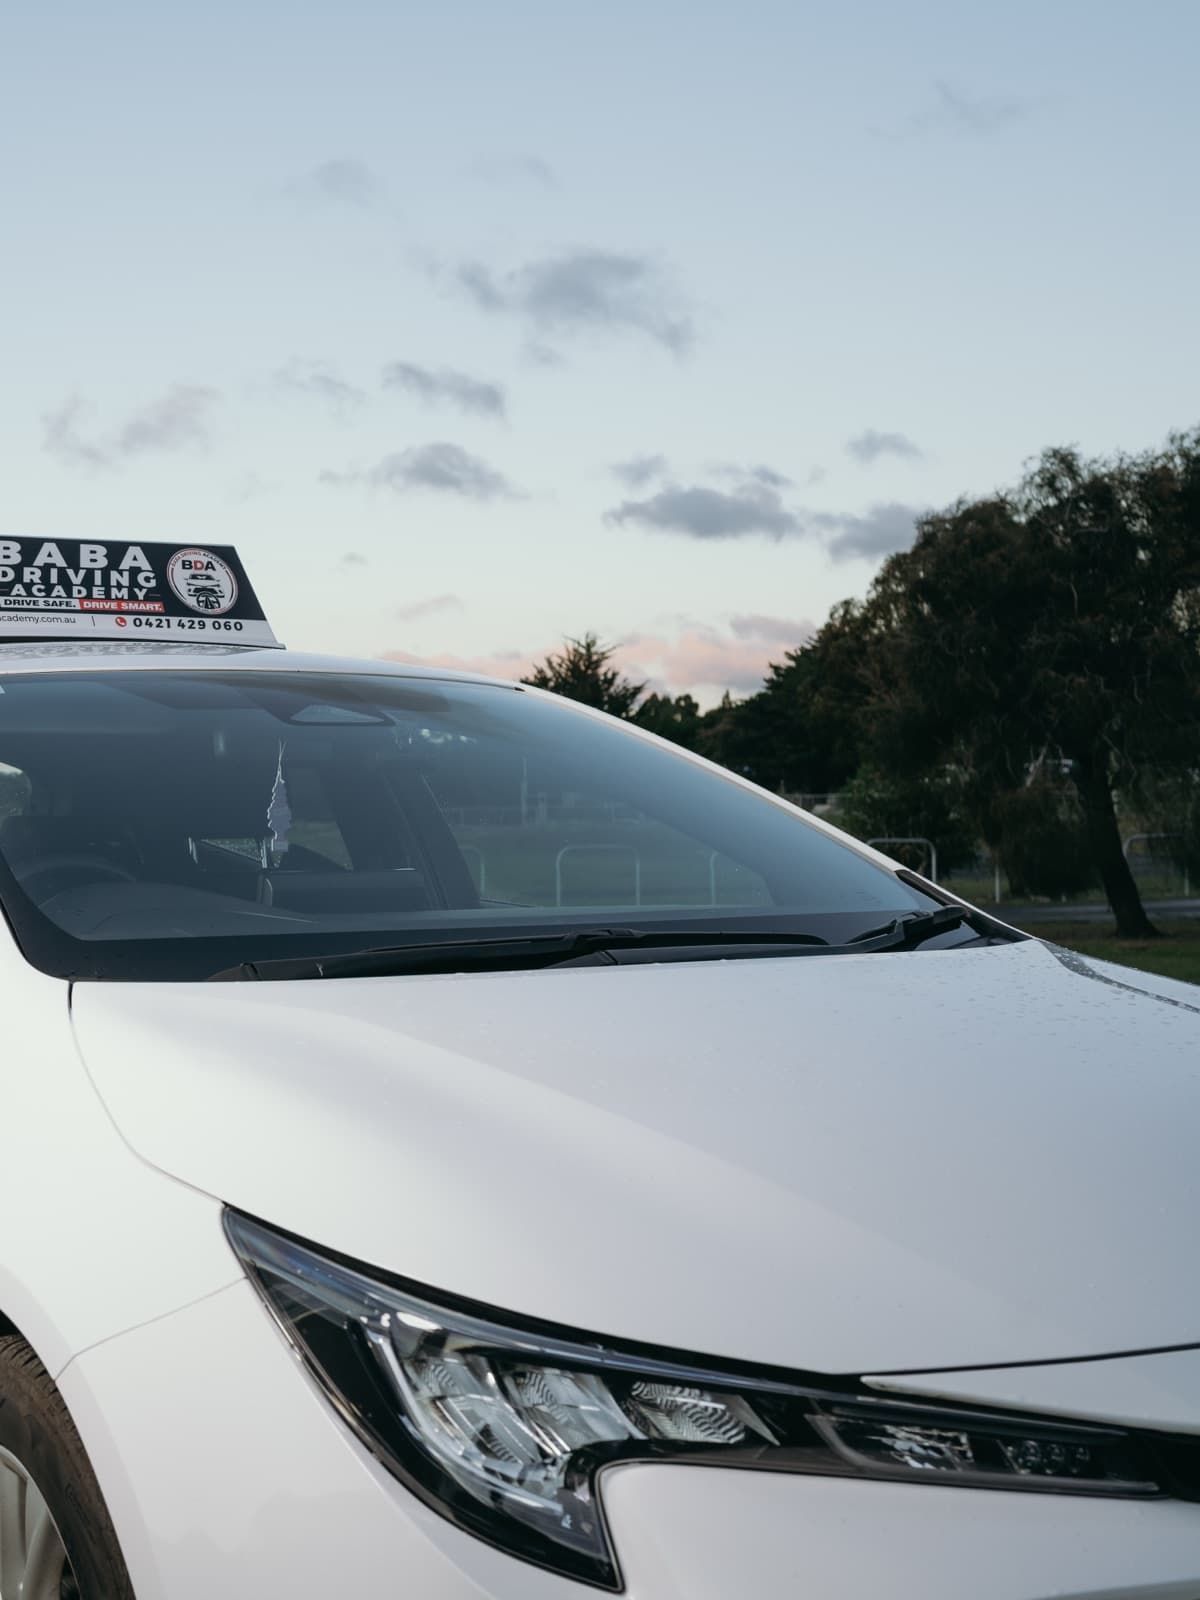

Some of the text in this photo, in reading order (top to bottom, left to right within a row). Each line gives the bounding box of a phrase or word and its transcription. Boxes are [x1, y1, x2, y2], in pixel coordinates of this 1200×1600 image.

[182, 560, 216, 571] BDA
[10, 583, 148, 600] ACADEMY
[4, 599, 162, 611] DRIVE SAFE. DRIVE SMART.
[133, 617, 243, 631] 0421 429 060
